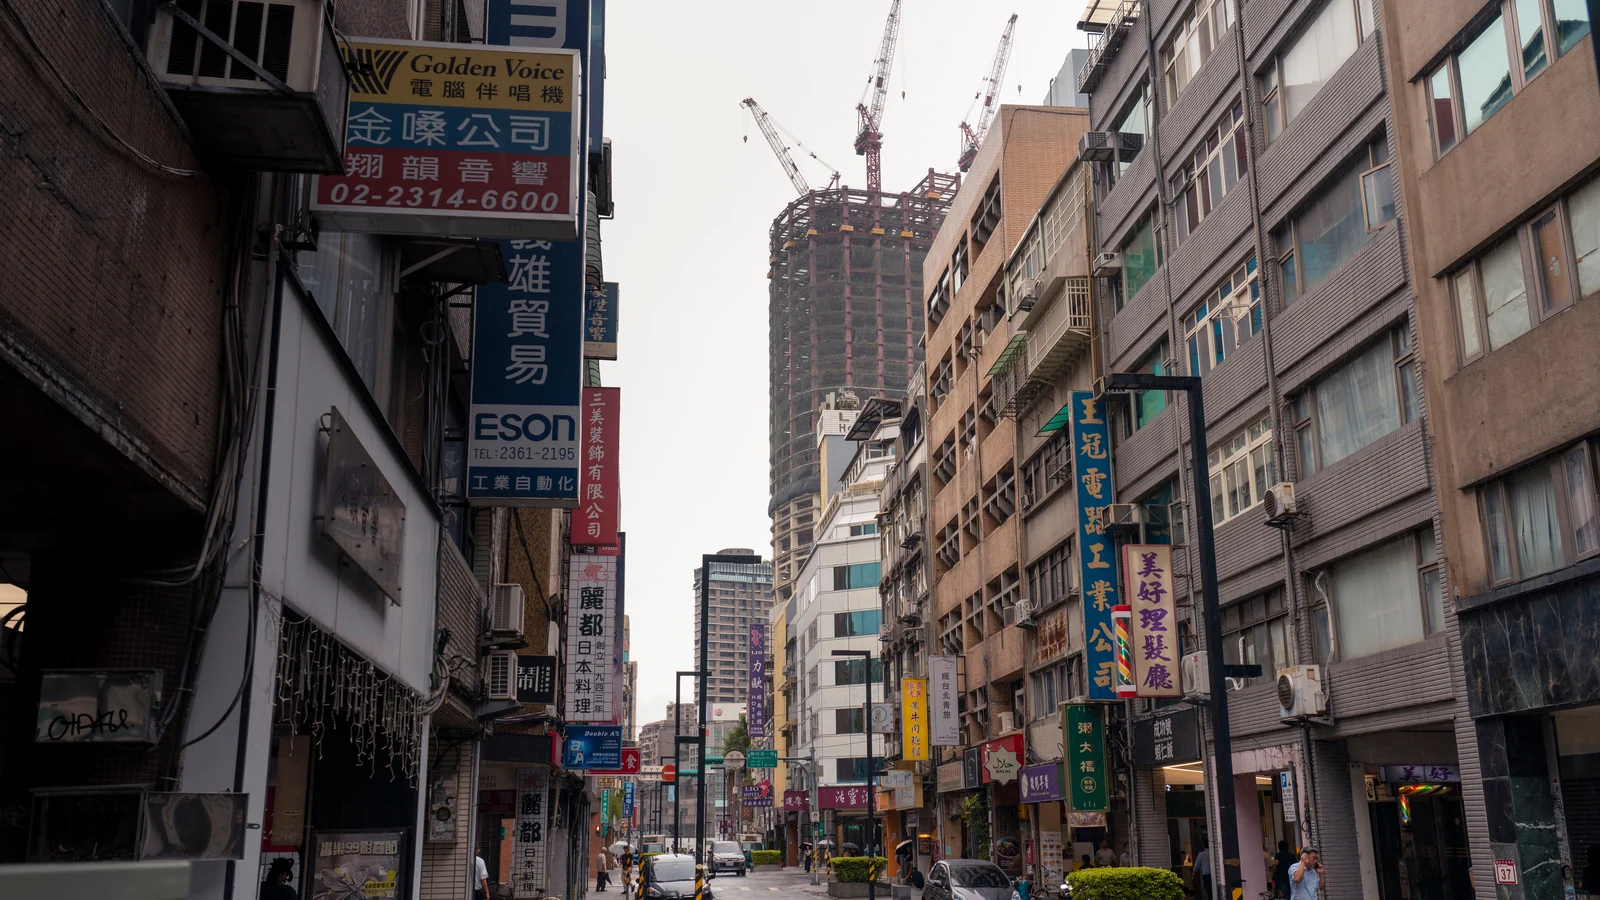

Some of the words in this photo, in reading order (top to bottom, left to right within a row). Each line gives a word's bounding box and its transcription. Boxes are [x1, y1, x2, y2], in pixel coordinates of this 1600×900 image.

[410, 54, 497, 77] Golden
[504, 57, 565, 80] Voice
[410, 78, 564, 104] 電腦伴唱機
[348, 106, 550, 150] 金嗓公司
[346, 153, 548, 186] 翔韻音響
[330, 183, 559, 212] 02-2314-6600
[474, 446, 576, 461] TEL:2361-2195
[585, 392, 606, 538] 三美裝飾有限公司
[472, 475, 574, 491] 工業自動化
[1079, 398, 1118, 694] 王冠電器工業公司
[579, 586, 605, 637] 麗都
[1136, 551, 1173, 691] 美好理髮廳
[574, 641, 592, 714] 日本料理
[992, 756, 1014, 769] حلال
[1077, 722, 1095, 772] 粥大福
[1400, 765, 1453, 782] 美好
[519, 793, 542, 843] 麗都
[523, 848, 535, 892] 日本料理
[1500, 868, 1512, 880] 37
